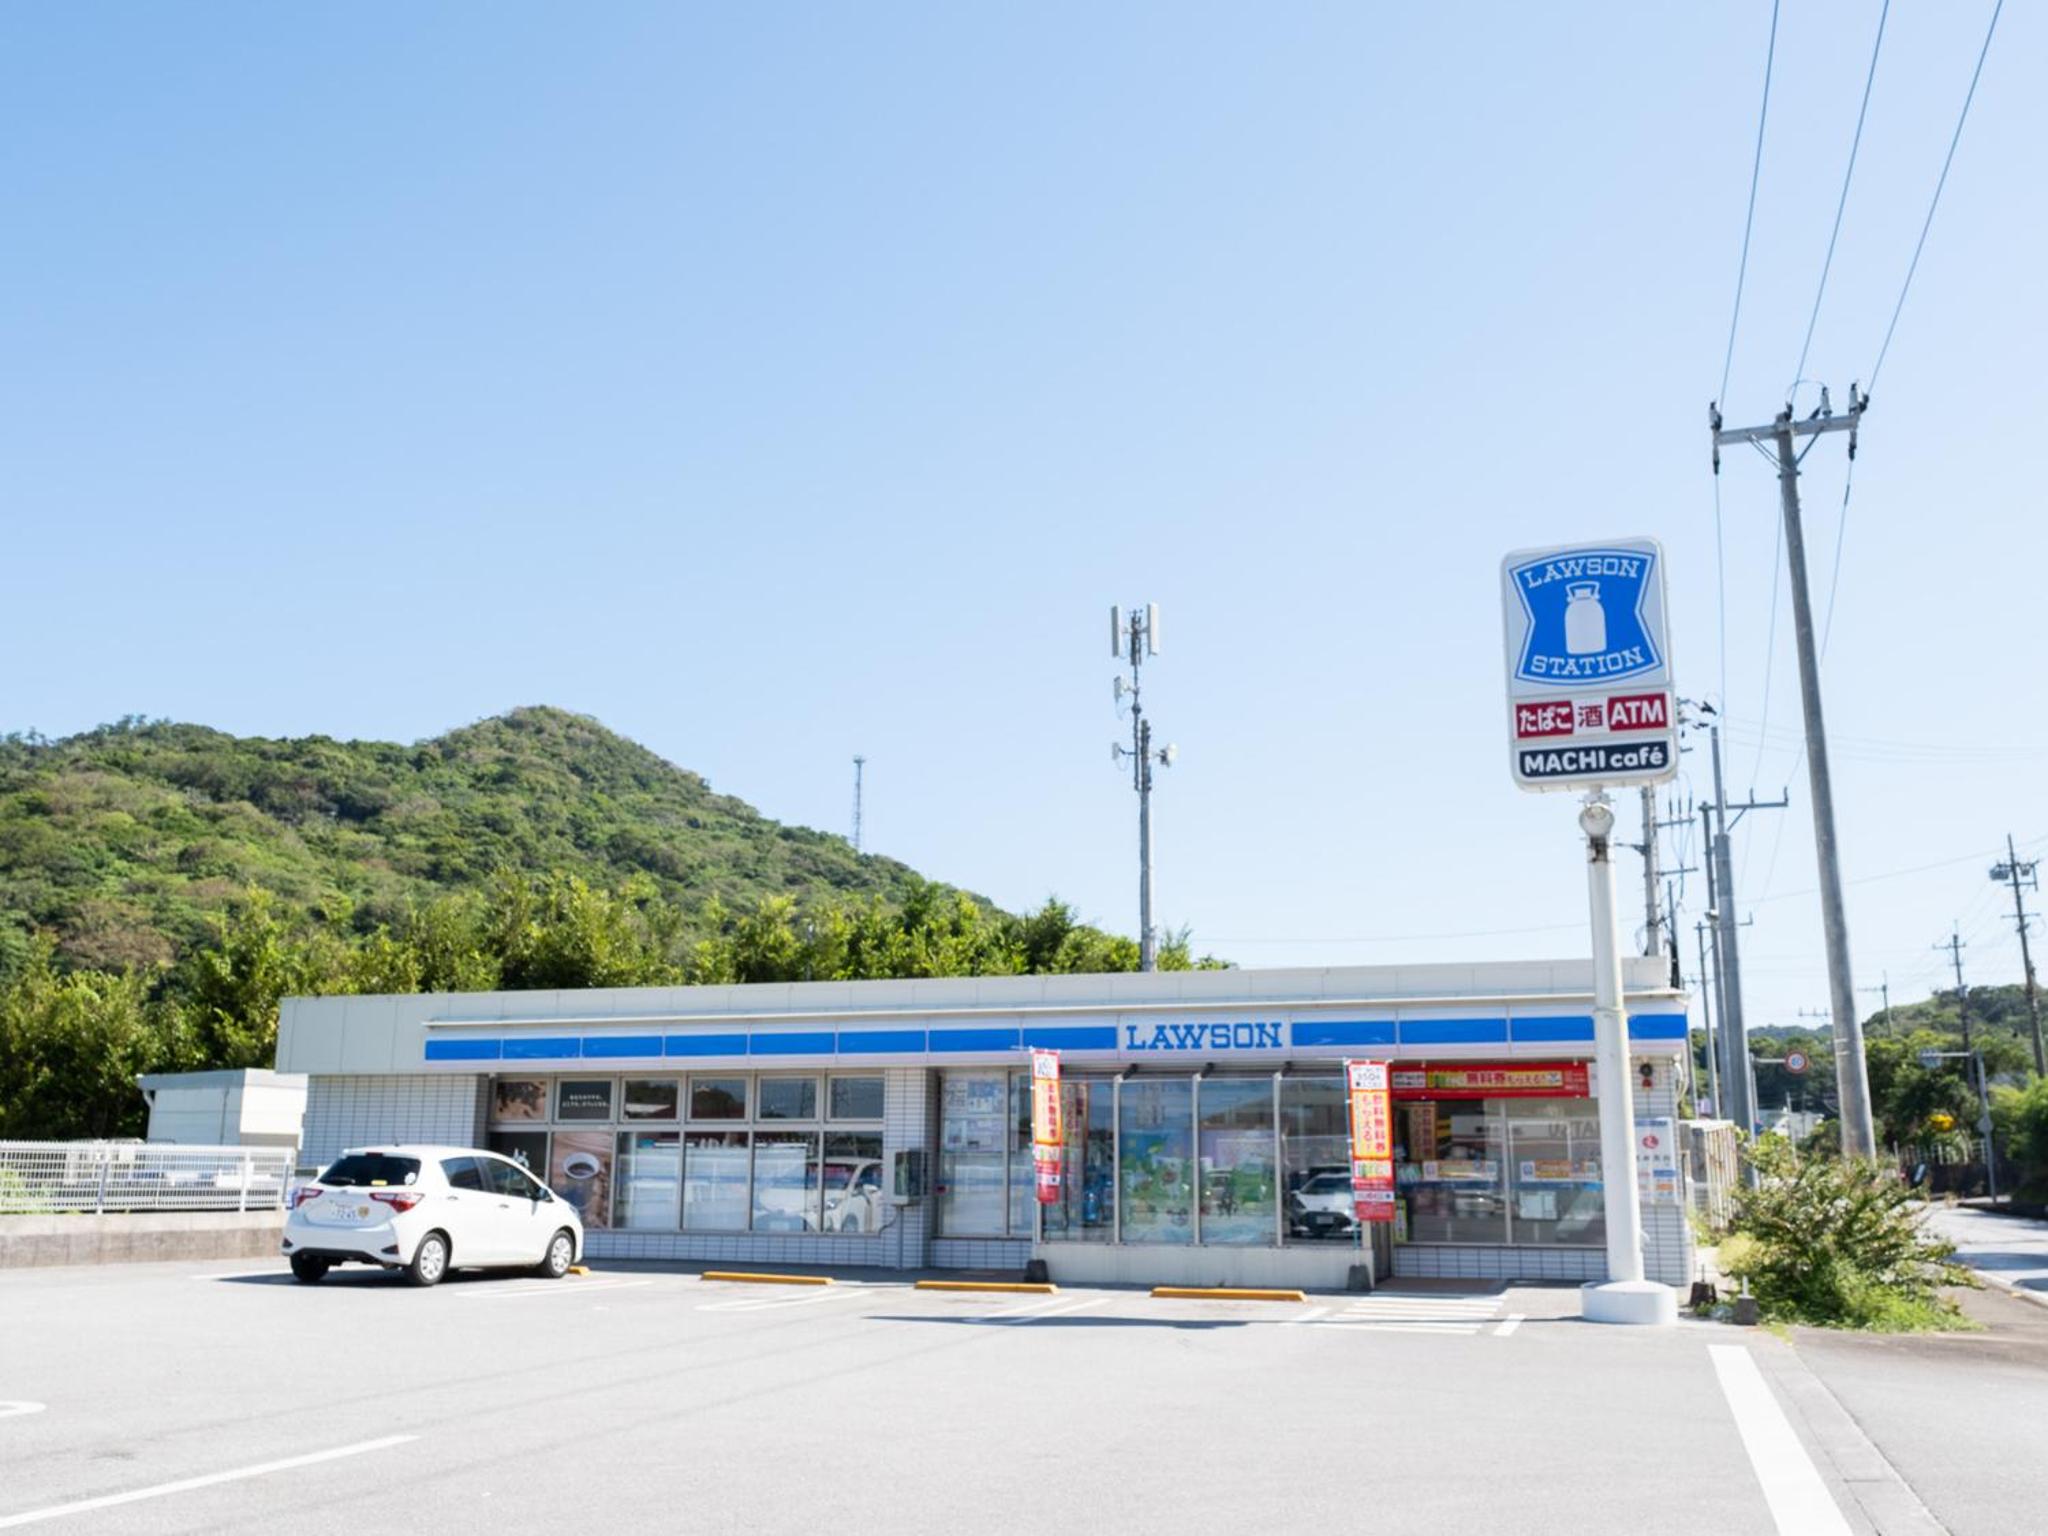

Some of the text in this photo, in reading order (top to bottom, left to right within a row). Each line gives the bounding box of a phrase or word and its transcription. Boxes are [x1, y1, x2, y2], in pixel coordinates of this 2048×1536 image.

[1524, 557, 1641, 588] LAWSON
[1530, 646, 1645, 676] STATION
[1518, 698, 1665, 733] たばこ 酒 ATM
[1523, 746, 1664, 774] MACHI café
[1126, 1022, 1282, 1050] LAWSON
